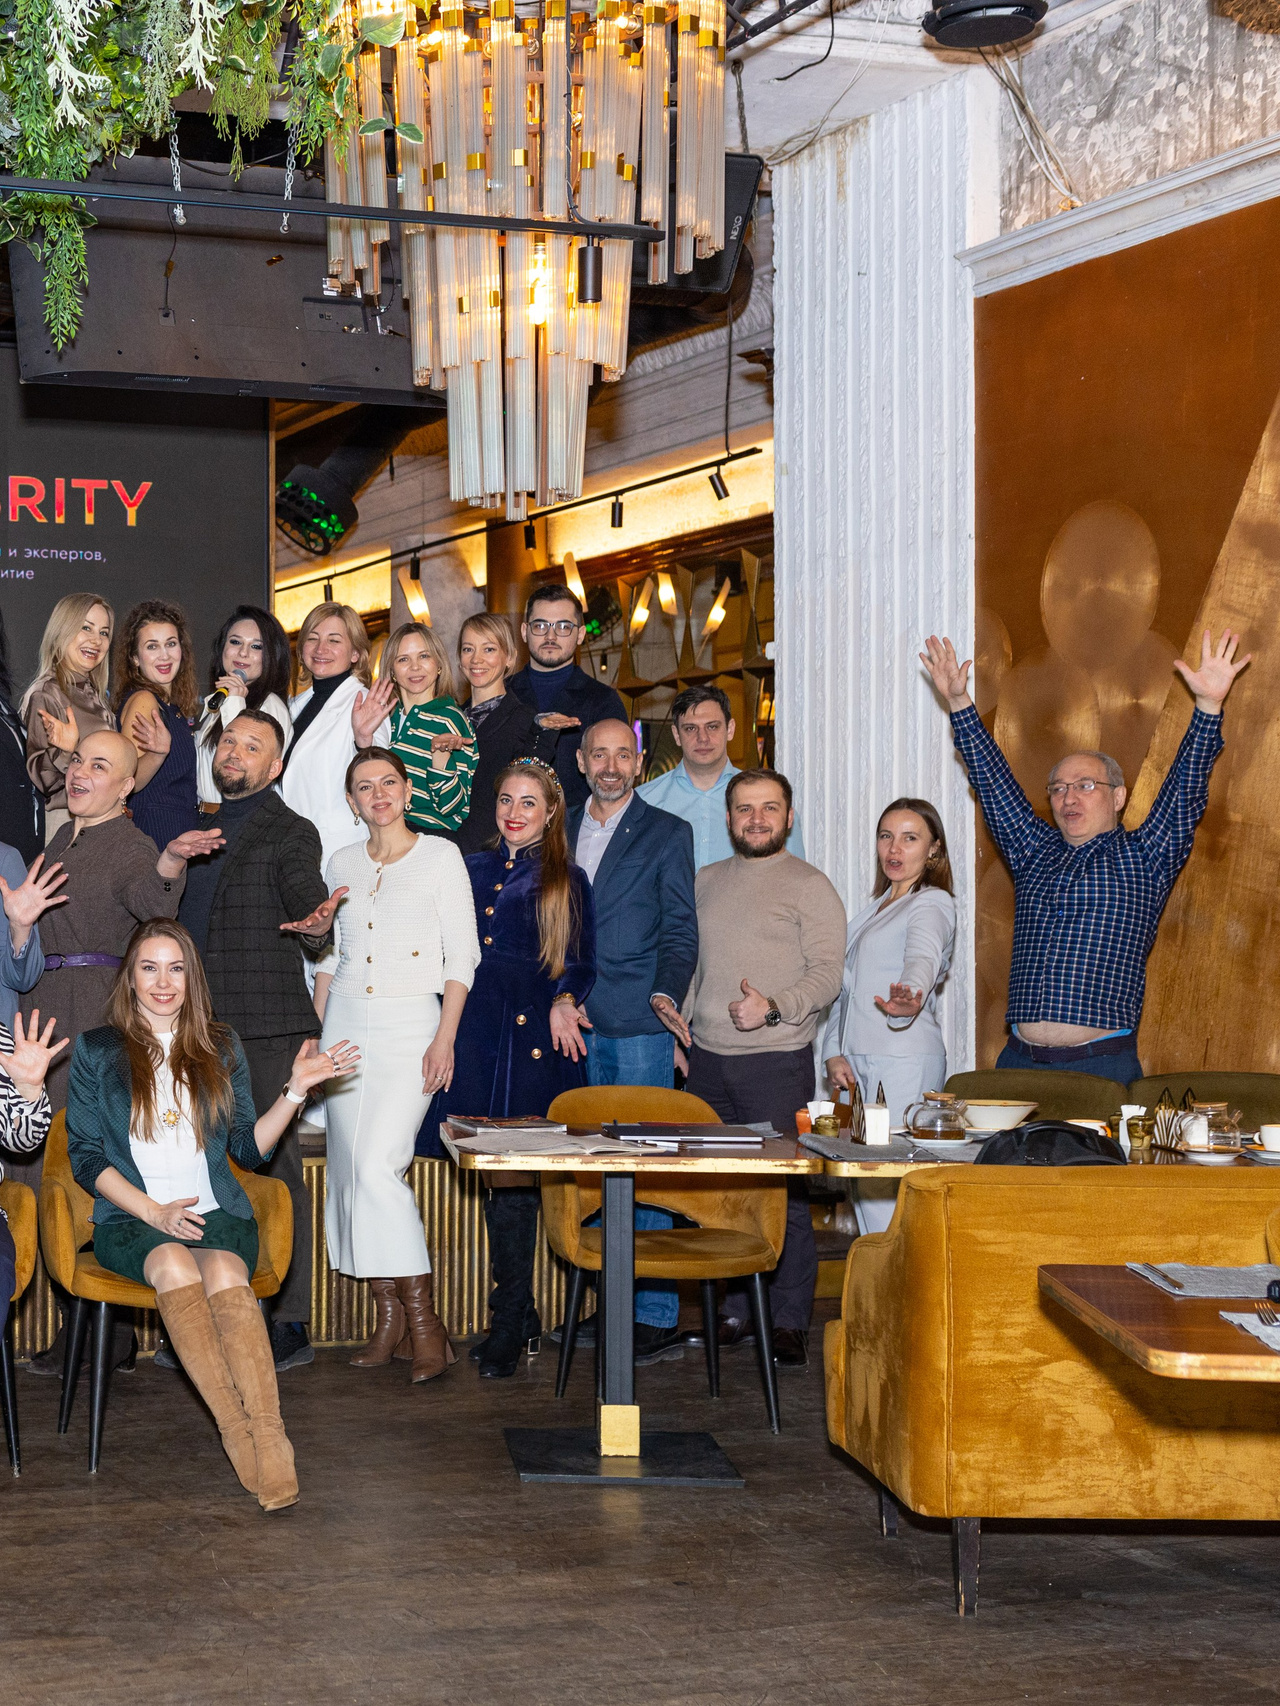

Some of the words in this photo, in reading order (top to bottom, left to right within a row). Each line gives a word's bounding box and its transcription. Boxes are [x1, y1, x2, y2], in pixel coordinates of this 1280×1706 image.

[729, 215, 743, 240] NEXO
[9, 548, 17, 557] и
[23, 548, 107, 563] экспертов,
